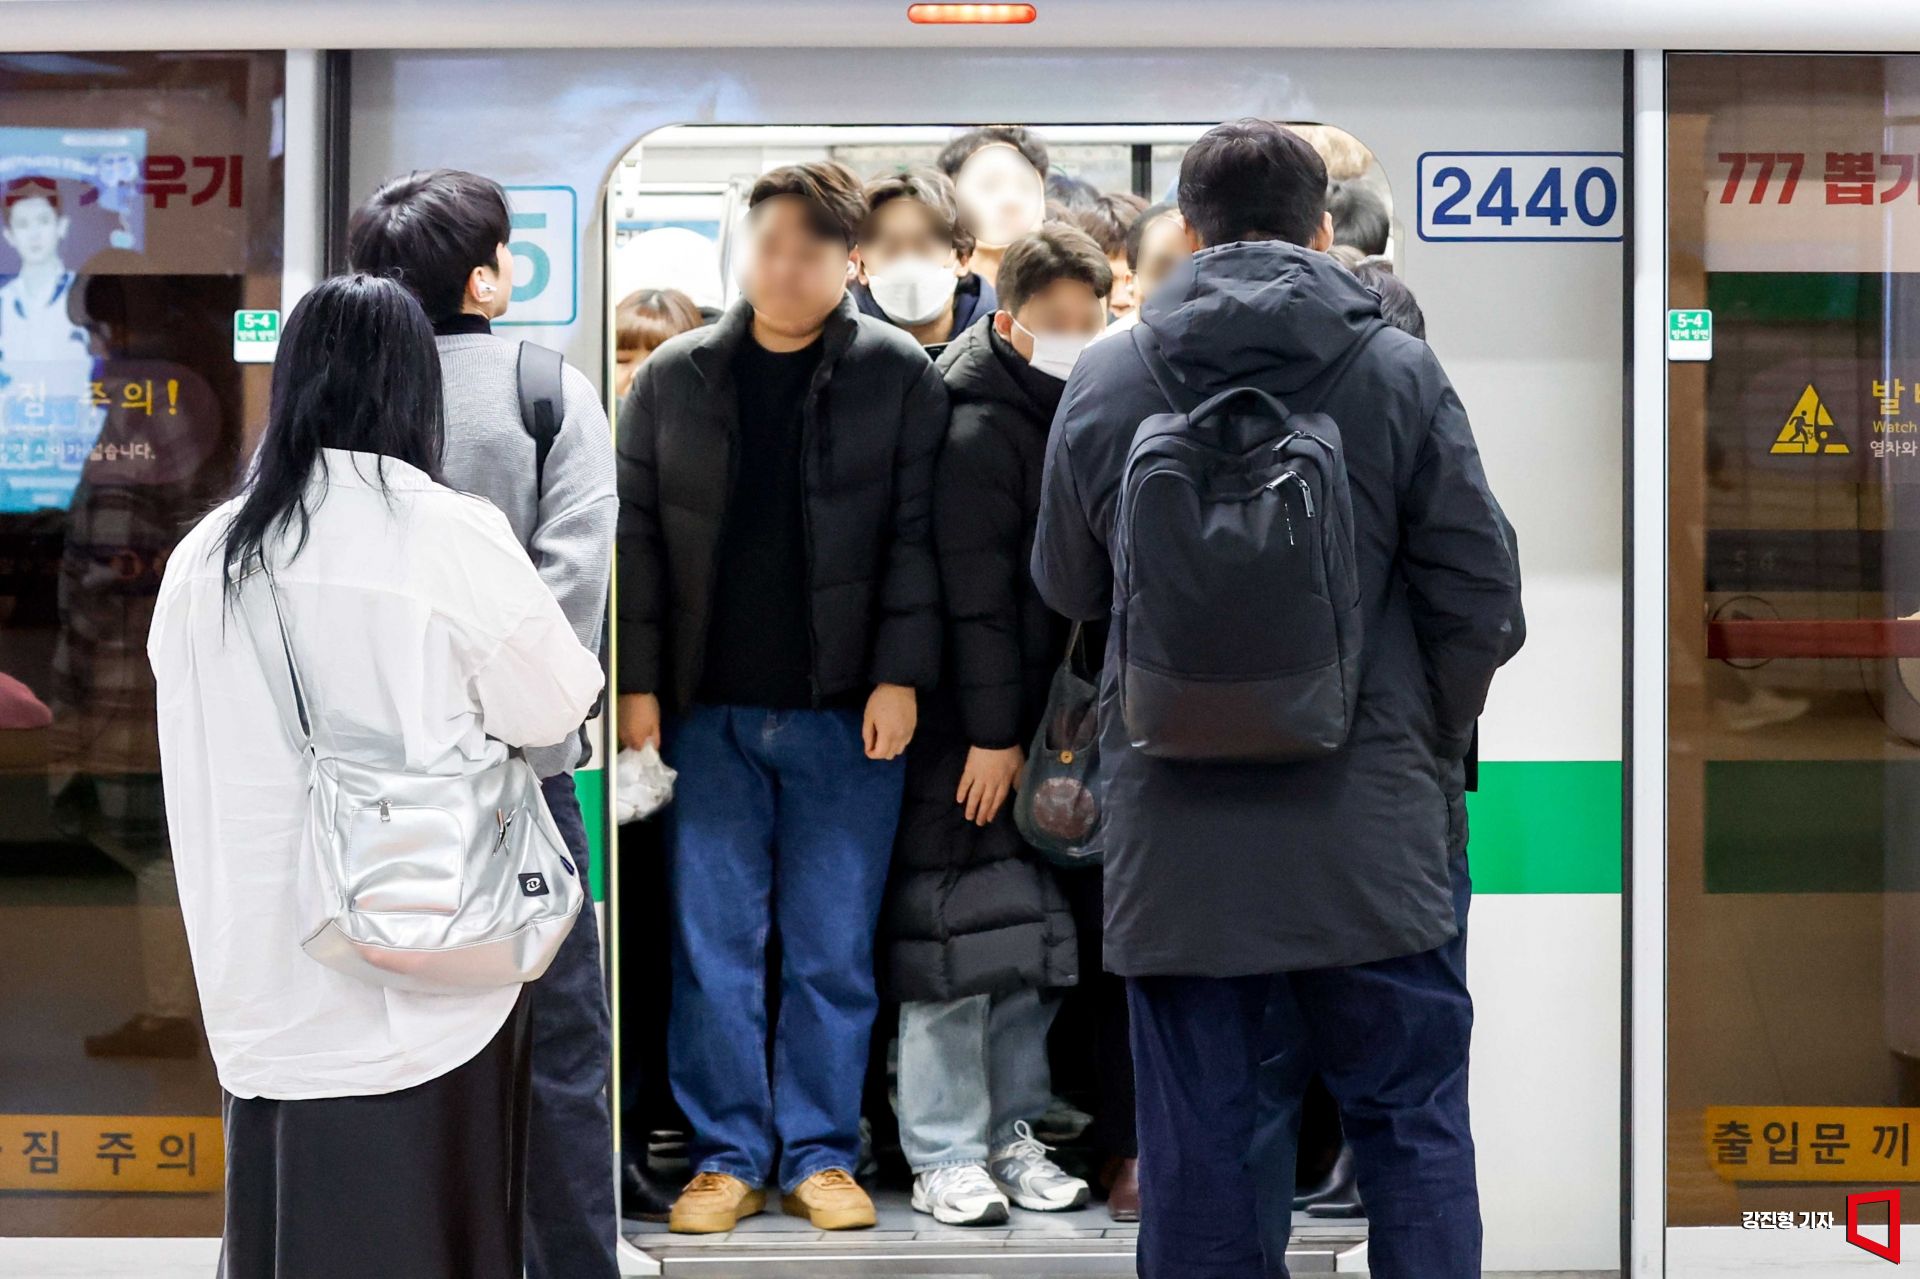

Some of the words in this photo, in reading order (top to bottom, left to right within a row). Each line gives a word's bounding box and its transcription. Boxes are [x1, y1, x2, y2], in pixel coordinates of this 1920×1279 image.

[80, 155, 243, 208] 우기
[1432, 167, 1617, 226] 2440
[1718, 152, 1805, 204] 777
[1824, 152, 1920, 205] 뽑기
[244, 313, 271, 328] 5-4
[1678, 313, 1703, 328] 5-4
[79, 379, 179, 417] 주의!
[1872, 421, 1918, 433] Watch
[1870, 440, 1918, 457] 열차와
[0, 1130, 59, 1174] 짐
[96, 1131, 196, 1177] 주의
[1712, 1121, 1850, 1165] 출입문
[1872, 1123, 1909, 1167] 끼
[1002, 1164, 1020, 1179] N
